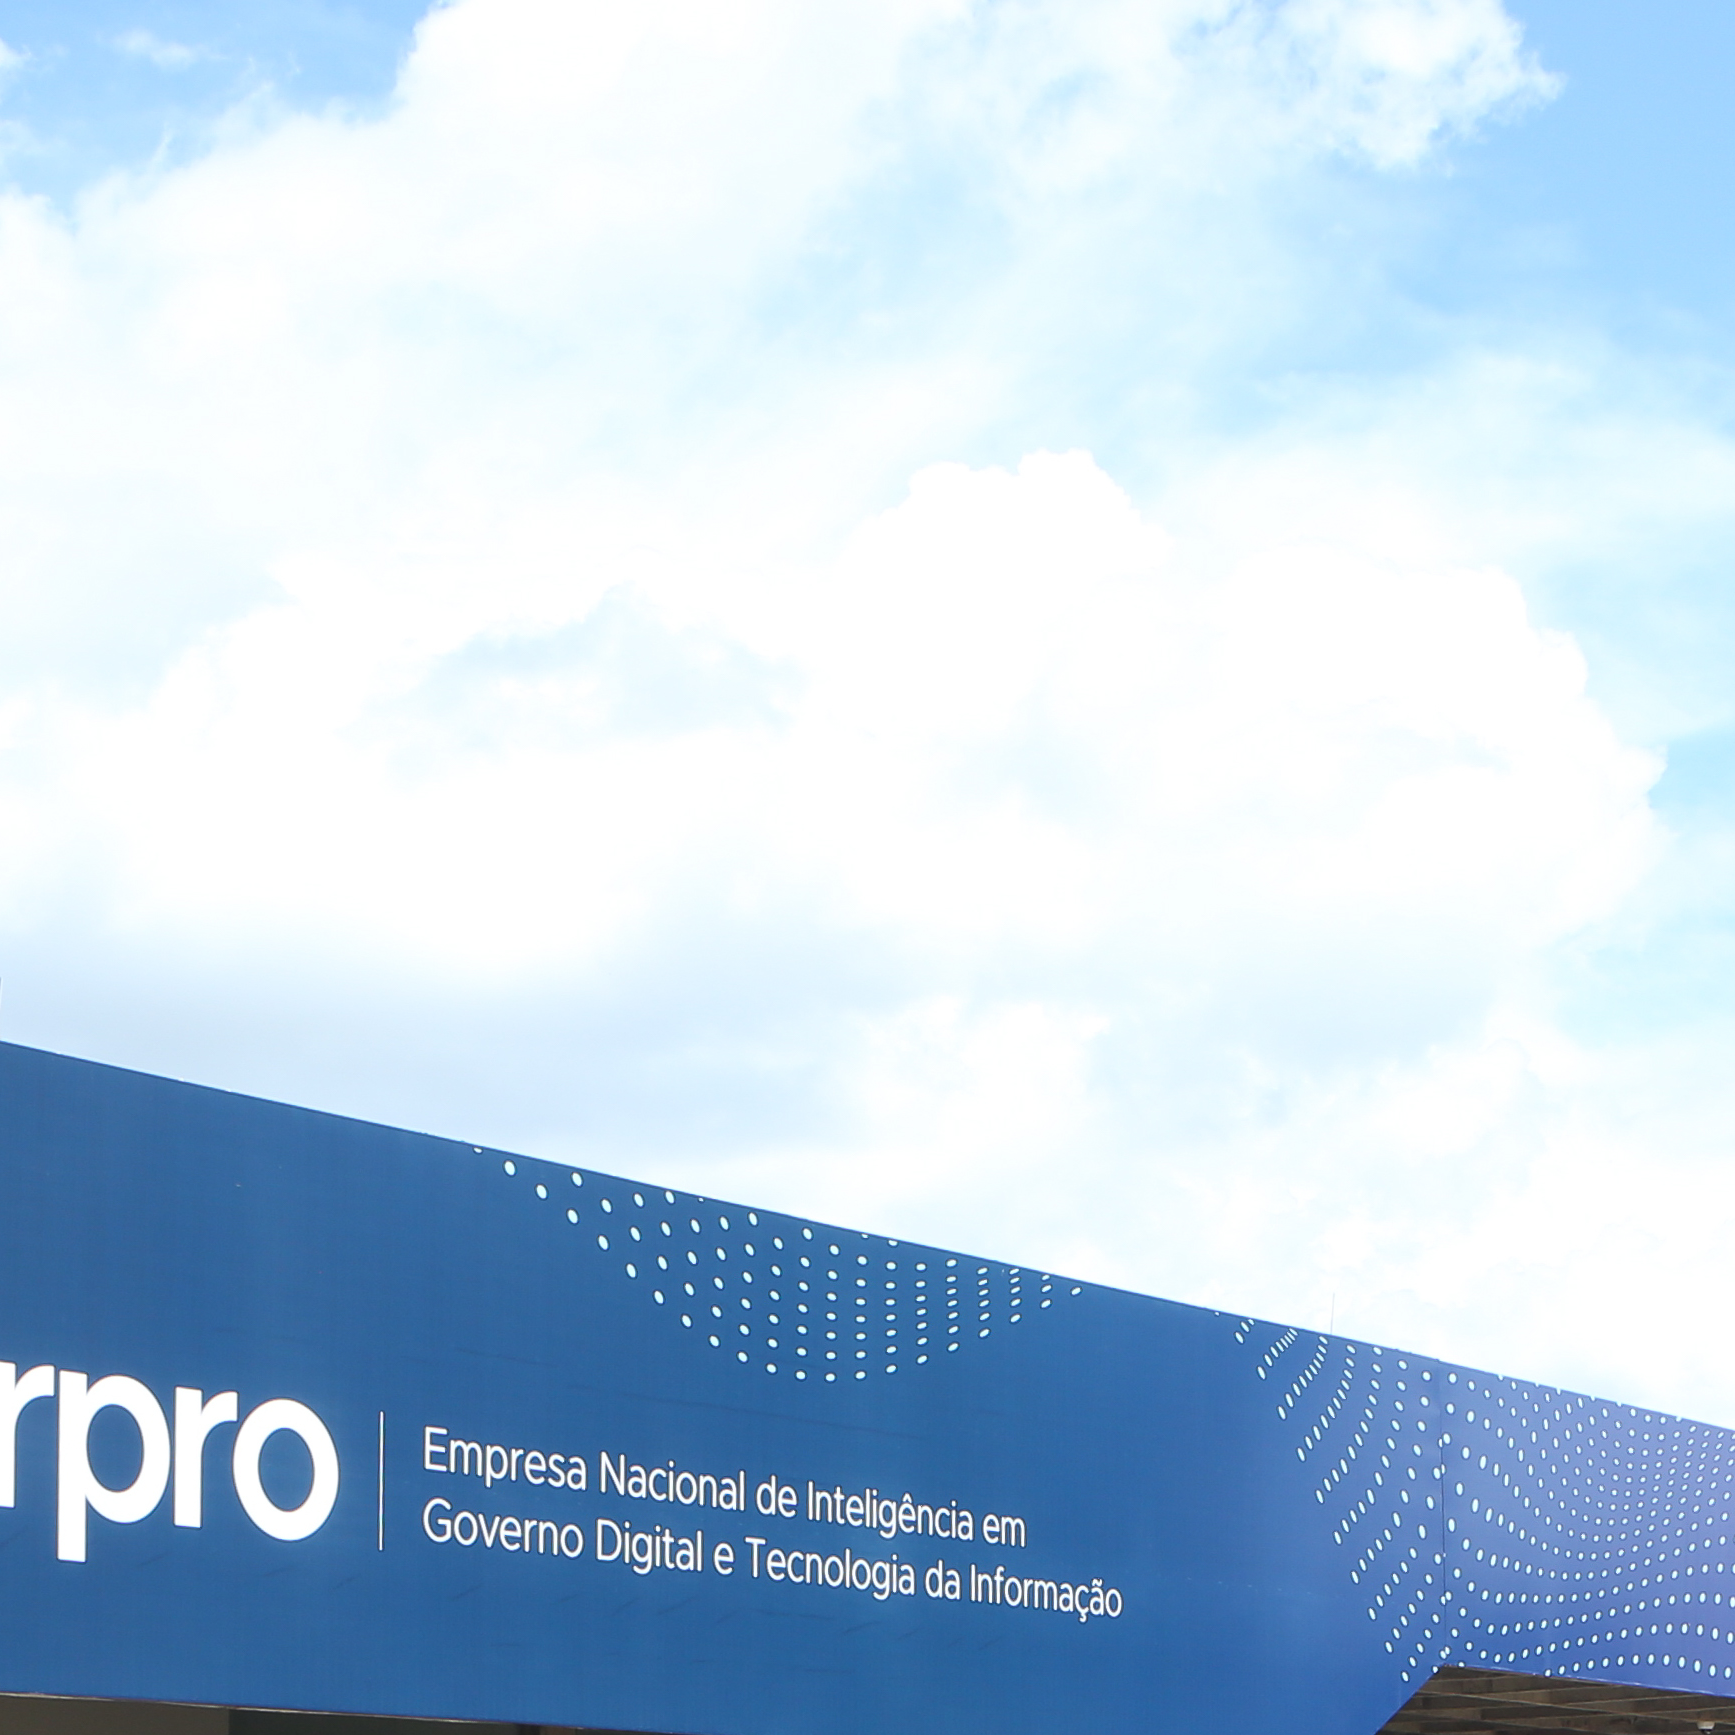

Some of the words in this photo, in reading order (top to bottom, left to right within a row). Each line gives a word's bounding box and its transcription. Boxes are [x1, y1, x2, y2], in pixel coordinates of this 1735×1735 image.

[423, 1424, 588, 1491] Empresa
[599, 1450, 746, 1512] Nacional
[755, 1473, 799, 1519] de
[807, 1479, 975, 1541] Inteligência
[981, 1512, 1027, 1549] em
[421, 1496, 585, 1559] Governo
[595, 1517, 704, 1576] Digital
[712, 1541, 736, 1576] e
[743, 1535, 916, 1602] Tecnologia
[923, 1558, 962, 1601] da
[969, 1563, 1124, 1624] Informação
